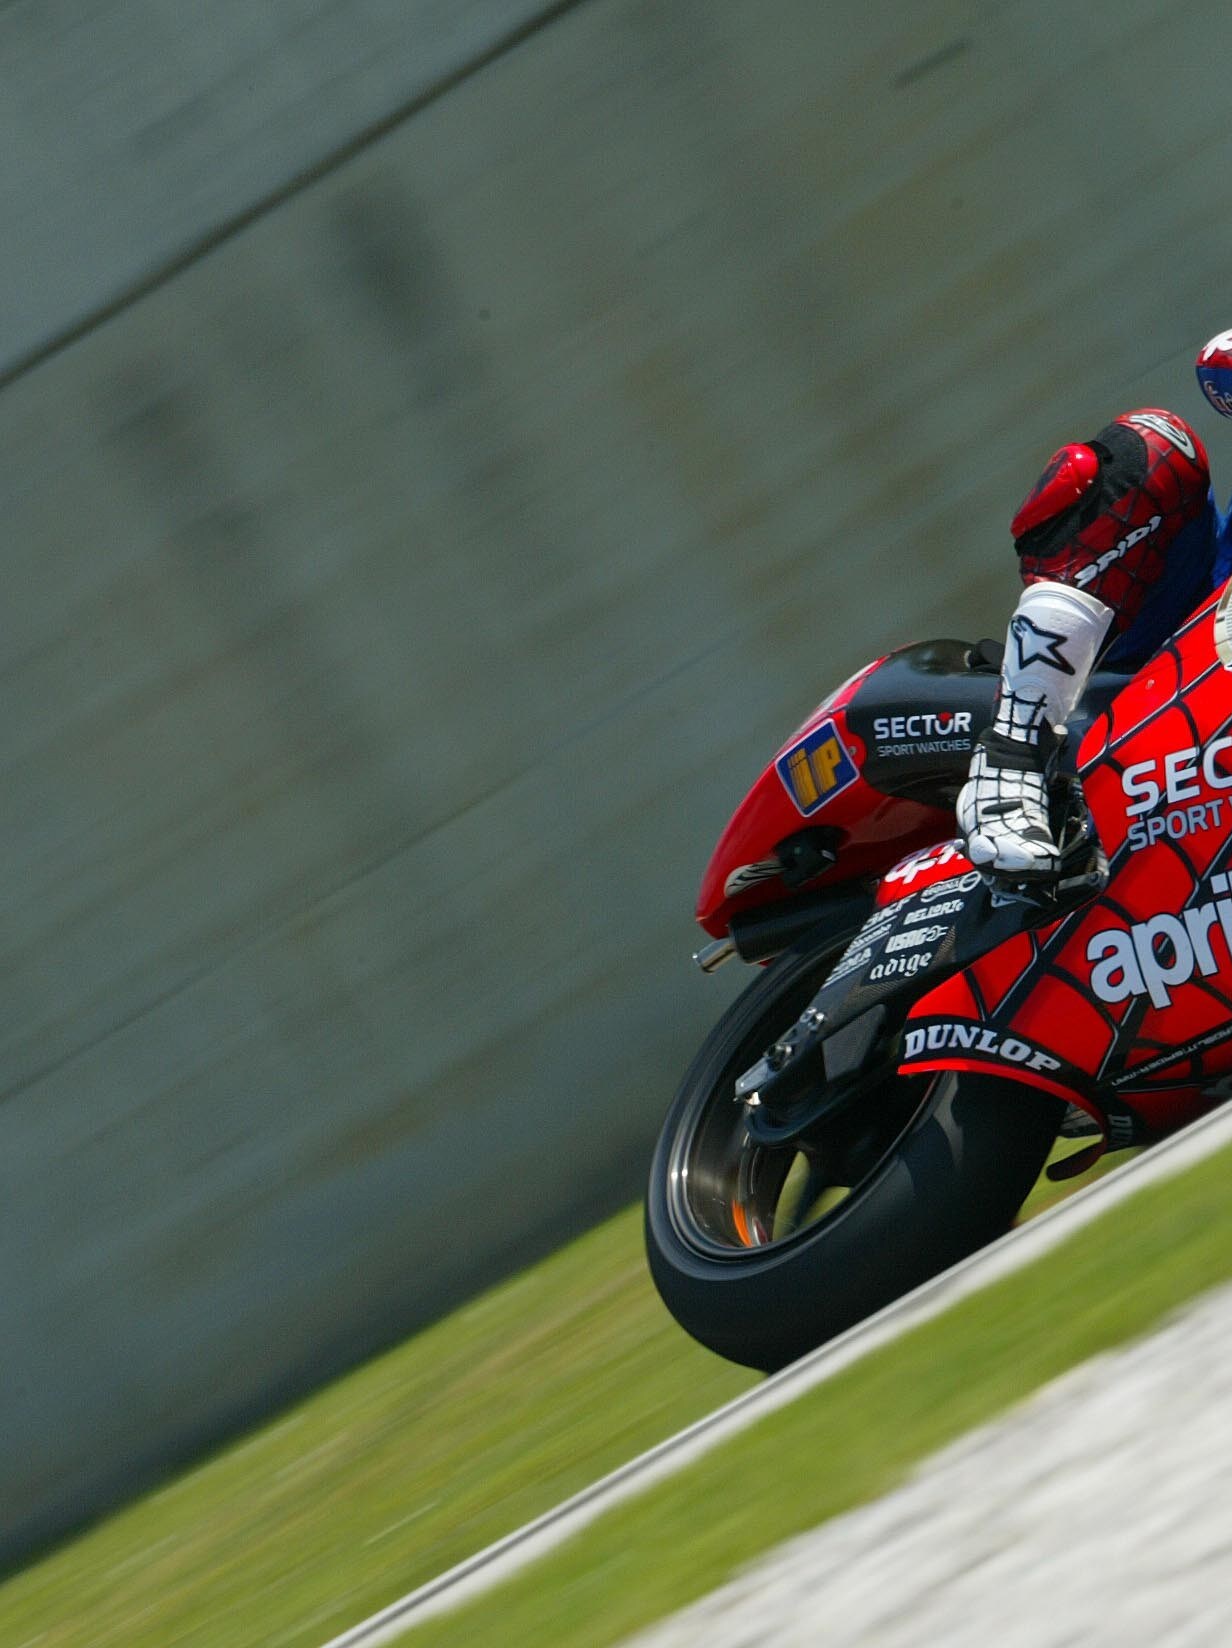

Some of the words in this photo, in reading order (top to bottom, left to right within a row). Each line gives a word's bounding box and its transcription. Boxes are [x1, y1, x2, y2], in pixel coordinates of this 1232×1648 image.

[873, 712, 972, 739] SECTOR
[878, 743, 915, 758] SPORT
[916, 738, 972, 755] WATCHES
[1127, 799, 1223, 851] SPORT
[869, 951, 932, 980] adige
[904, 1024, 1061, 1071] DUNLOP
